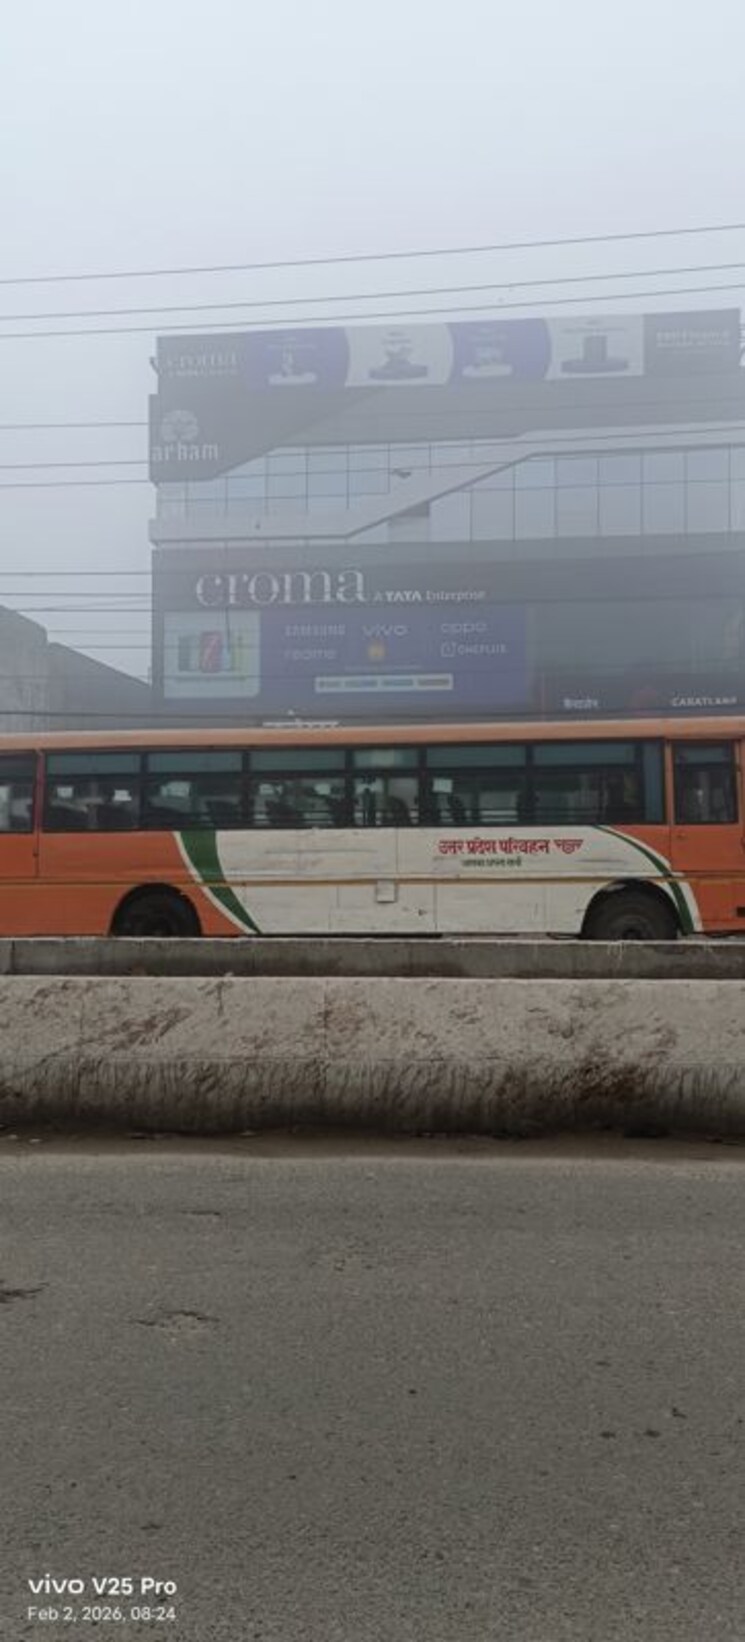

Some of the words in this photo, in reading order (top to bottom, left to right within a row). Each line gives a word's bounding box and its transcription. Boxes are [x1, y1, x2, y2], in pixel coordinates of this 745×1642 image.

[196, 569, 368, 607] croma
[385, 590, 422, 602] TATA
[362, 624, 409, 637] vivo
[466, 837, 496, 854] प्रदेश
[499, 837, 550, 854] परिवहन
